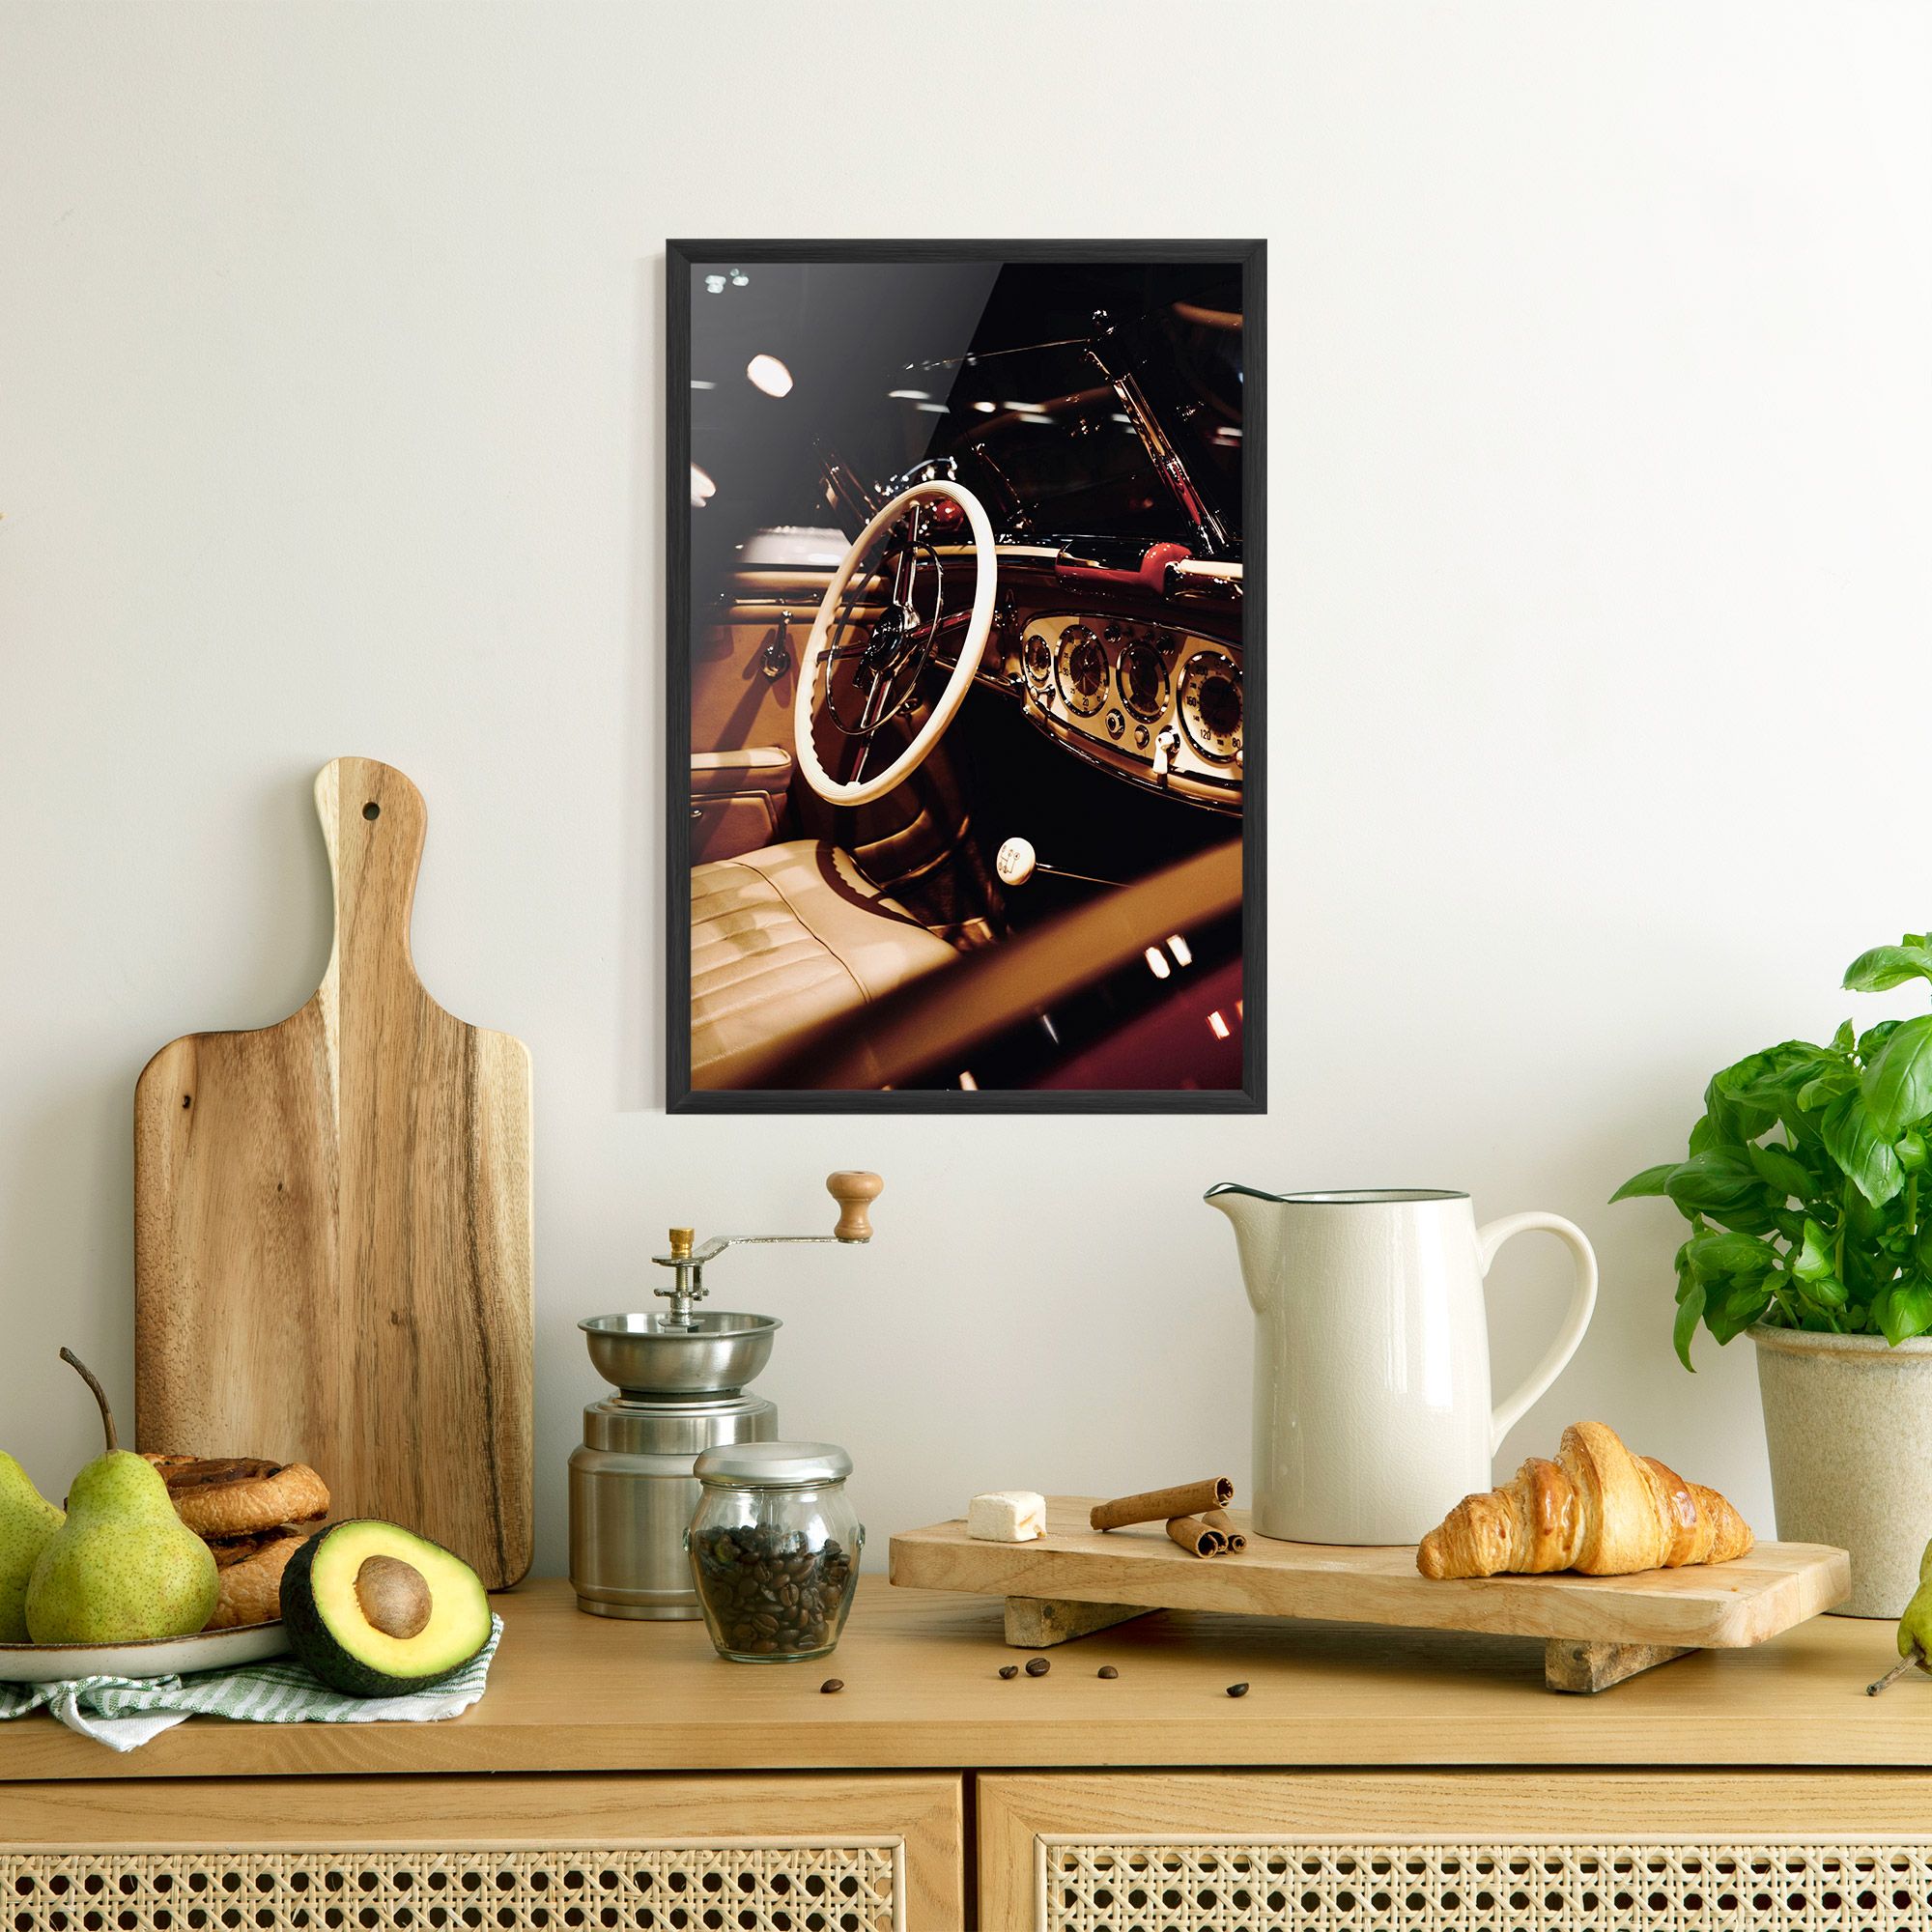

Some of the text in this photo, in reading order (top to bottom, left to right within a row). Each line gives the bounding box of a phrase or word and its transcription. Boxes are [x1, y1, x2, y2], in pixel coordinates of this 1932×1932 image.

[1082, 697, 1090, 707] 20
[1186, 696, 1197, 707] 160
[1201, 729, 1211, 741] 120
[1233, 737, 1241, 749] 80
